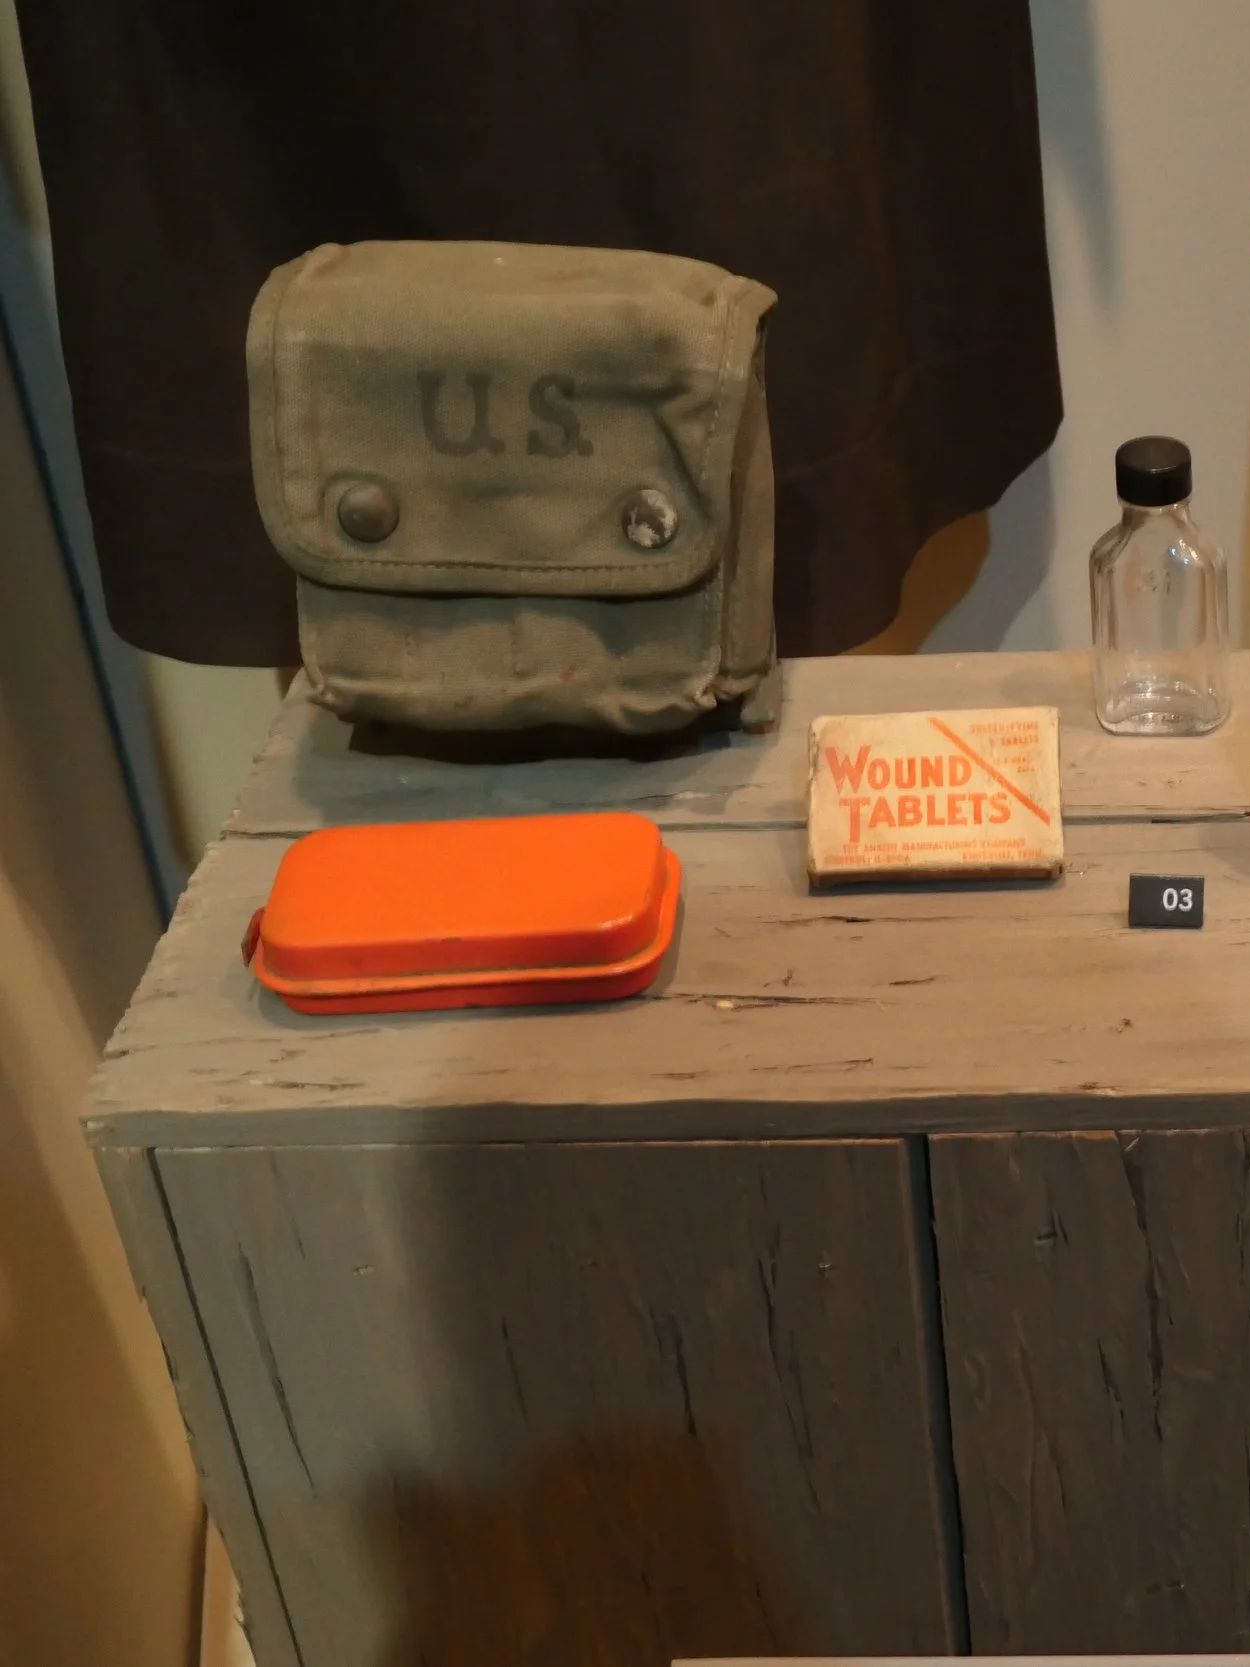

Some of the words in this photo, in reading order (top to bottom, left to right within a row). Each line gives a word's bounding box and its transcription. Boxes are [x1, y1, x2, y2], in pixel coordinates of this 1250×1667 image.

[415, 370, 594, 460] U.S.
[825, 745, 973, 795] WOUND
[839, 791, 1012, 843] TABLETS
[1162, 887, 1194, 912] 03
